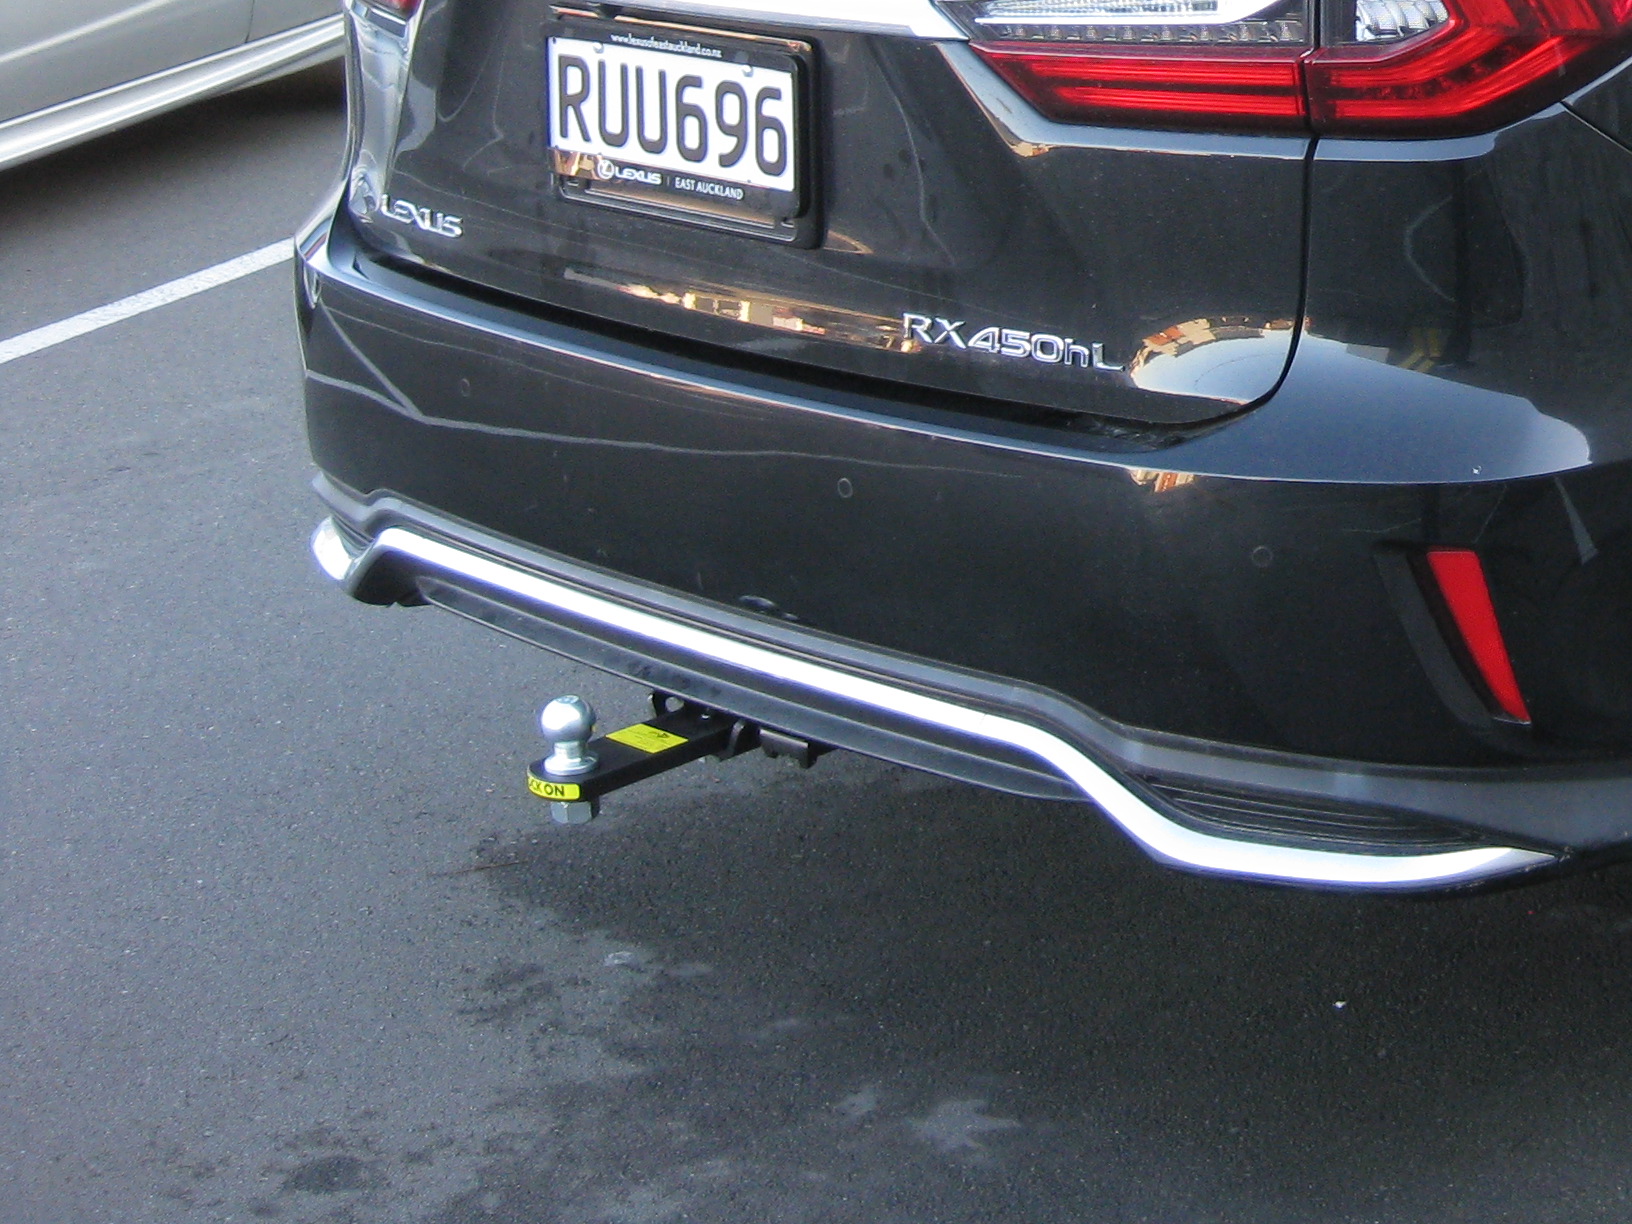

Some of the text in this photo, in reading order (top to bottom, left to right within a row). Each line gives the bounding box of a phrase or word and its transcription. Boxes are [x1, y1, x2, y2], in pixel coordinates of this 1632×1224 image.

[557, 54, 788, 177] RUU696
[614, 165, 744, 201] LEXUS EAST AUCKLAND
[381, 193, 463, 238] LEXUS
[543, 783, 566, 797] ON
